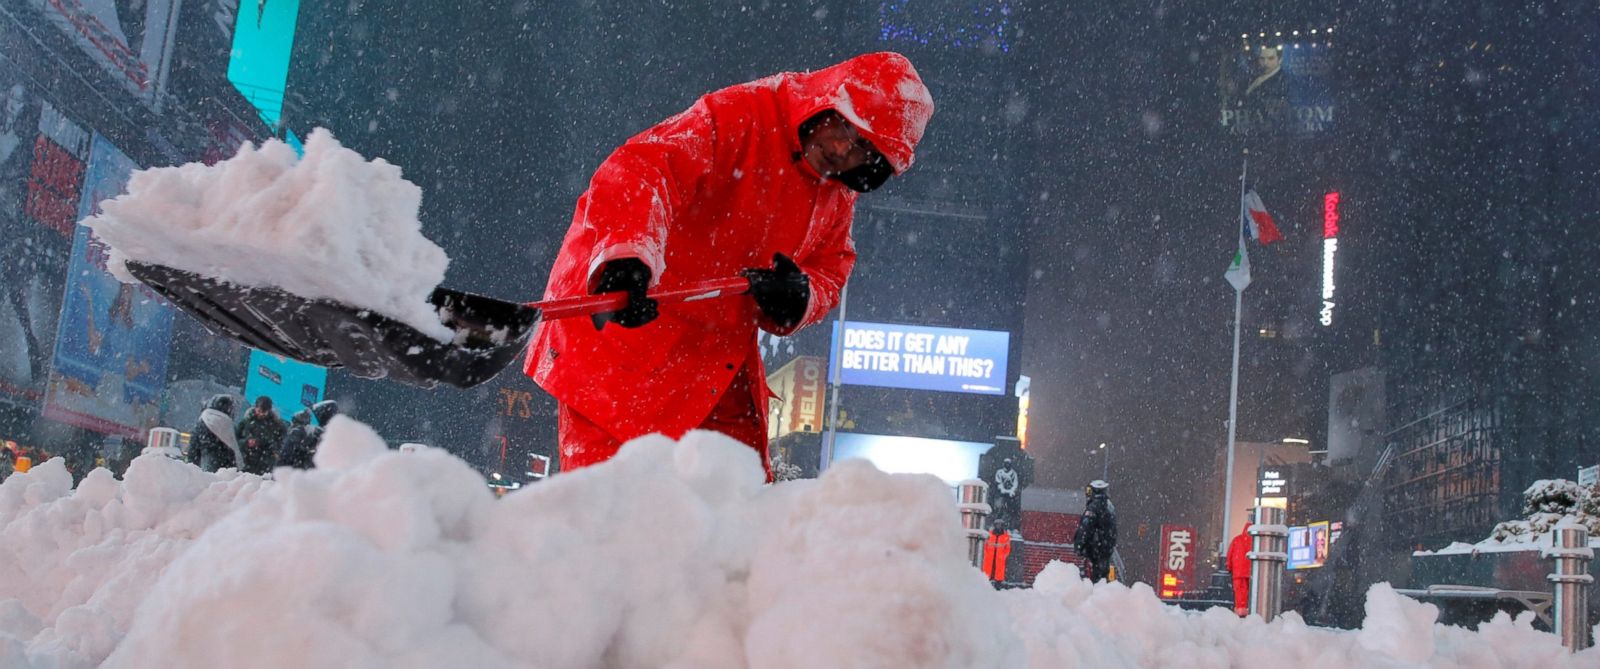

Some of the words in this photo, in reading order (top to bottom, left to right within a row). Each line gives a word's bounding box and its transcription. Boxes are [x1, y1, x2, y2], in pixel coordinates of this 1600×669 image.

[1220, 105, 1336, 127] PHATOM
[1324, 192, 1340, 237] Kodak
[1322, 238, 1338, 299] Moments
[1319, 300, 1336, 326] App
[844, 328, 885, 351] DOES
[886, 331, 904, 352] IT
[904, 332, 936, 354] GET
[935, 334, 970, 357] ANY
[842, 348, 900, 373] BETTER
[903, 353, 945, 376] THAN
[948, 355, 994, 379] THIS?
[1168, 529, 1192, 571] tkts
